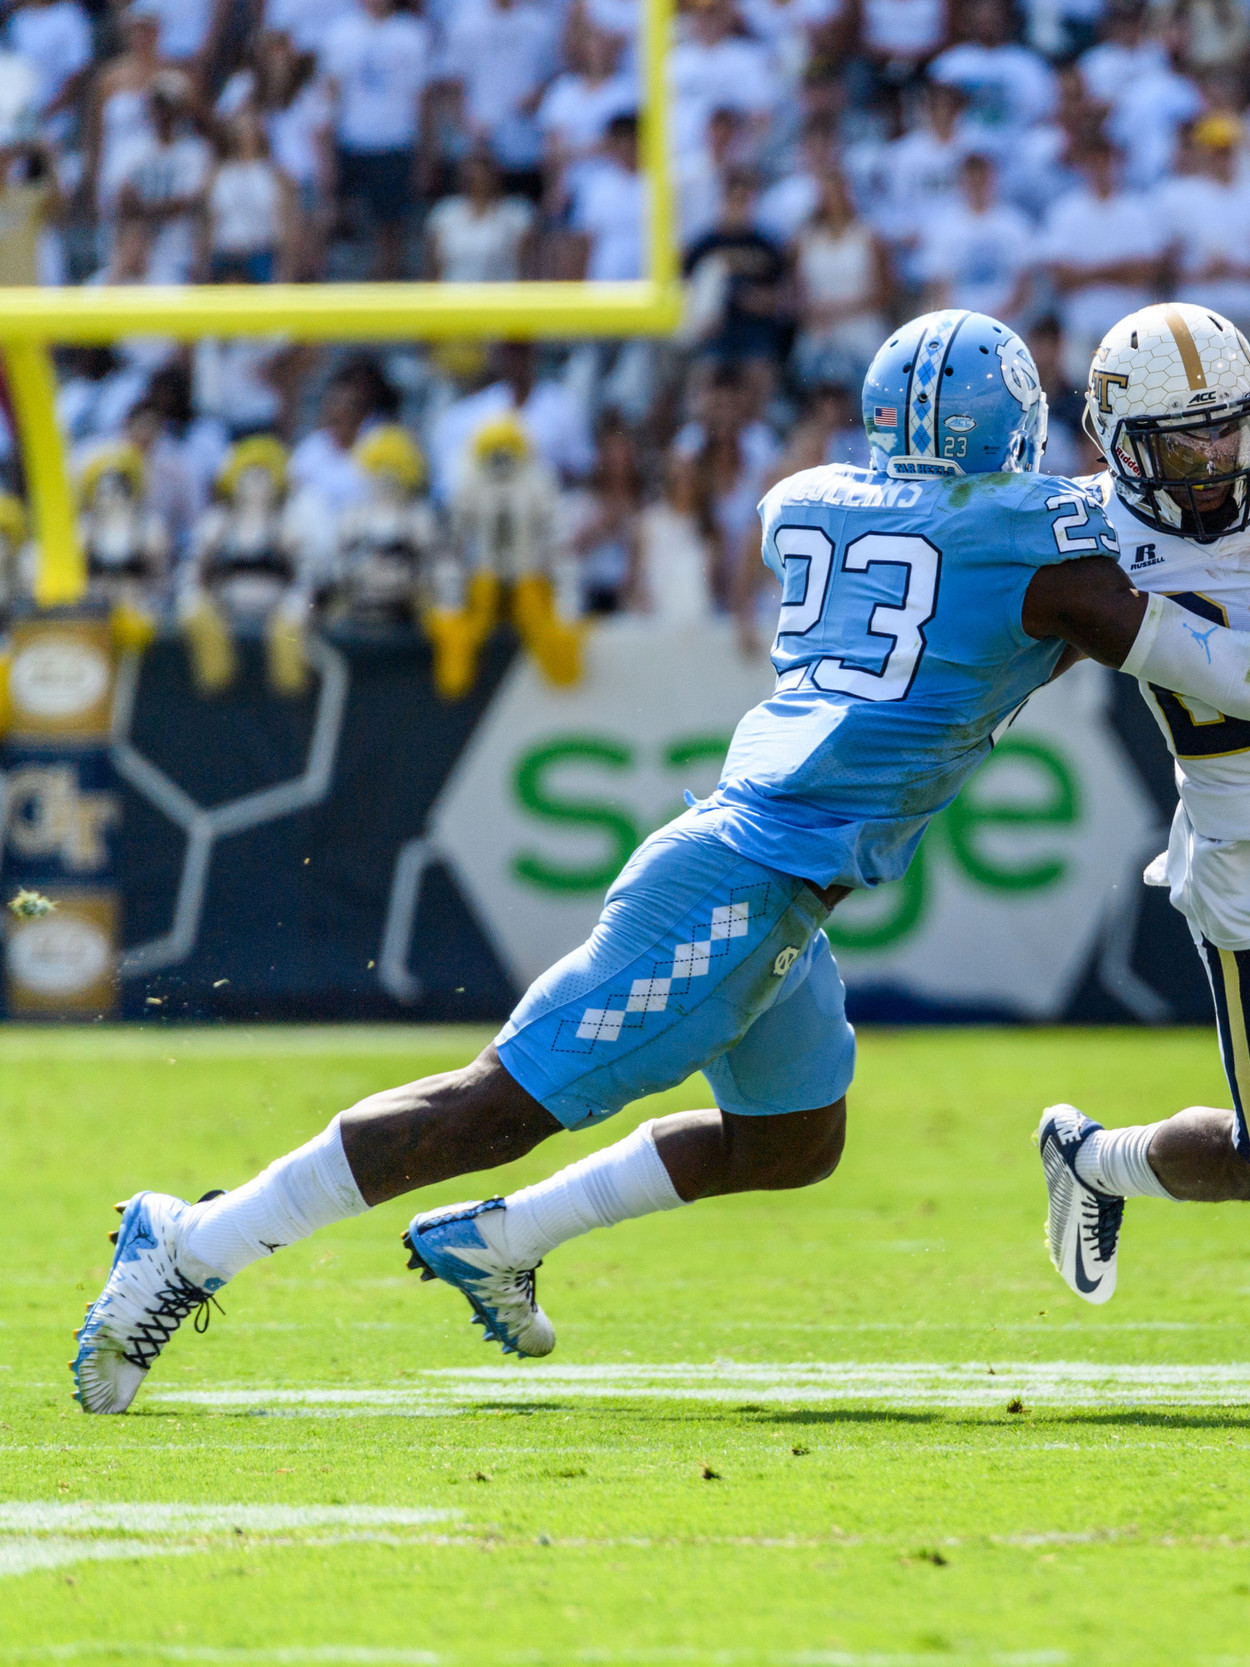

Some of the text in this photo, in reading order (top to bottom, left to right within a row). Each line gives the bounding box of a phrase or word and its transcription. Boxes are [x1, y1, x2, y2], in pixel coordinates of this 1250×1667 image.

[1188, 391, 1217, 404] ACC
[943, 435, 968, 458] 23
[893, 463, 956, 476] TAR HEELS
[1043, 492, 1121, 555] 23
[1130, 557, 1166, 571] RUSSELL
[772, 523, 943, 702] 23
